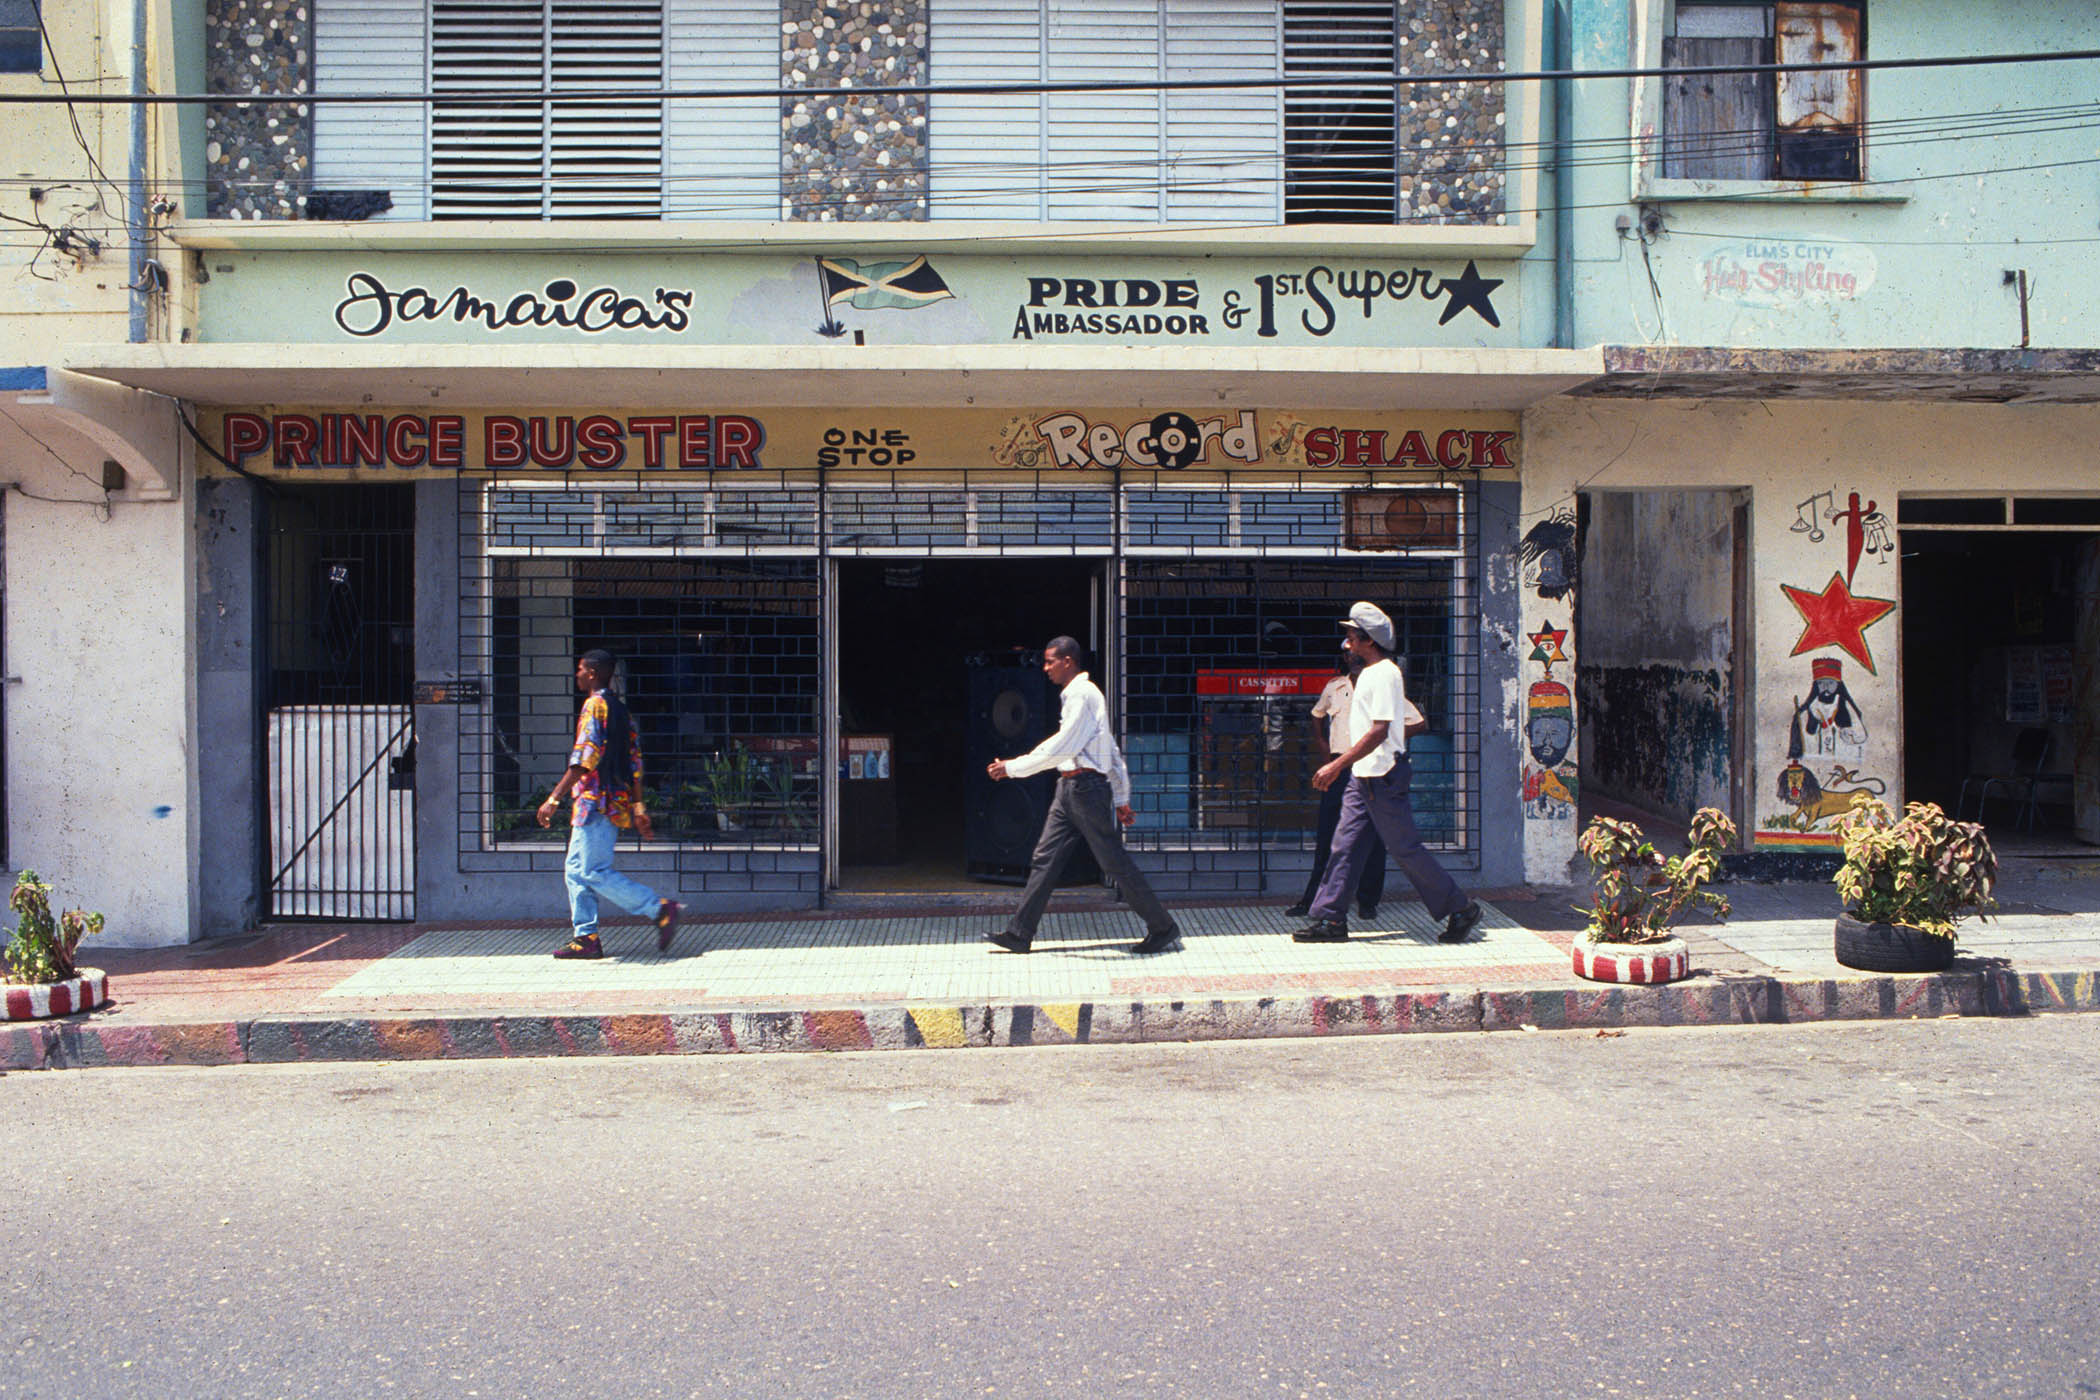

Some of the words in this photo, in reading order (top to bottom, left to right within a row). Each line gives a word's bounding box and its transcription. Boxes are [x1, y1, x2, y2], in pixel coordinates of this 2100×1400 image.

[1794, 243, 1835, 260] CITY
[1013, 304, 1210, 340] AMBASSADOR
[1222, 290, 1251, 329] &
[1302, 266, 1444, 336] Super
[1026, 277, 1200, 310] PRIDE
[224, 413, 466, 468] PRINCE
[484, 415, 767, 469] BUSTER
[823, 427, 910, 447] ONE
[1033, 408, 1263, 470] Record
[1303, 426, 1516, 469] SHACK
[817, 446, 916, 468] STOP
[1239, 677, 1298, 688] CASSETTES
